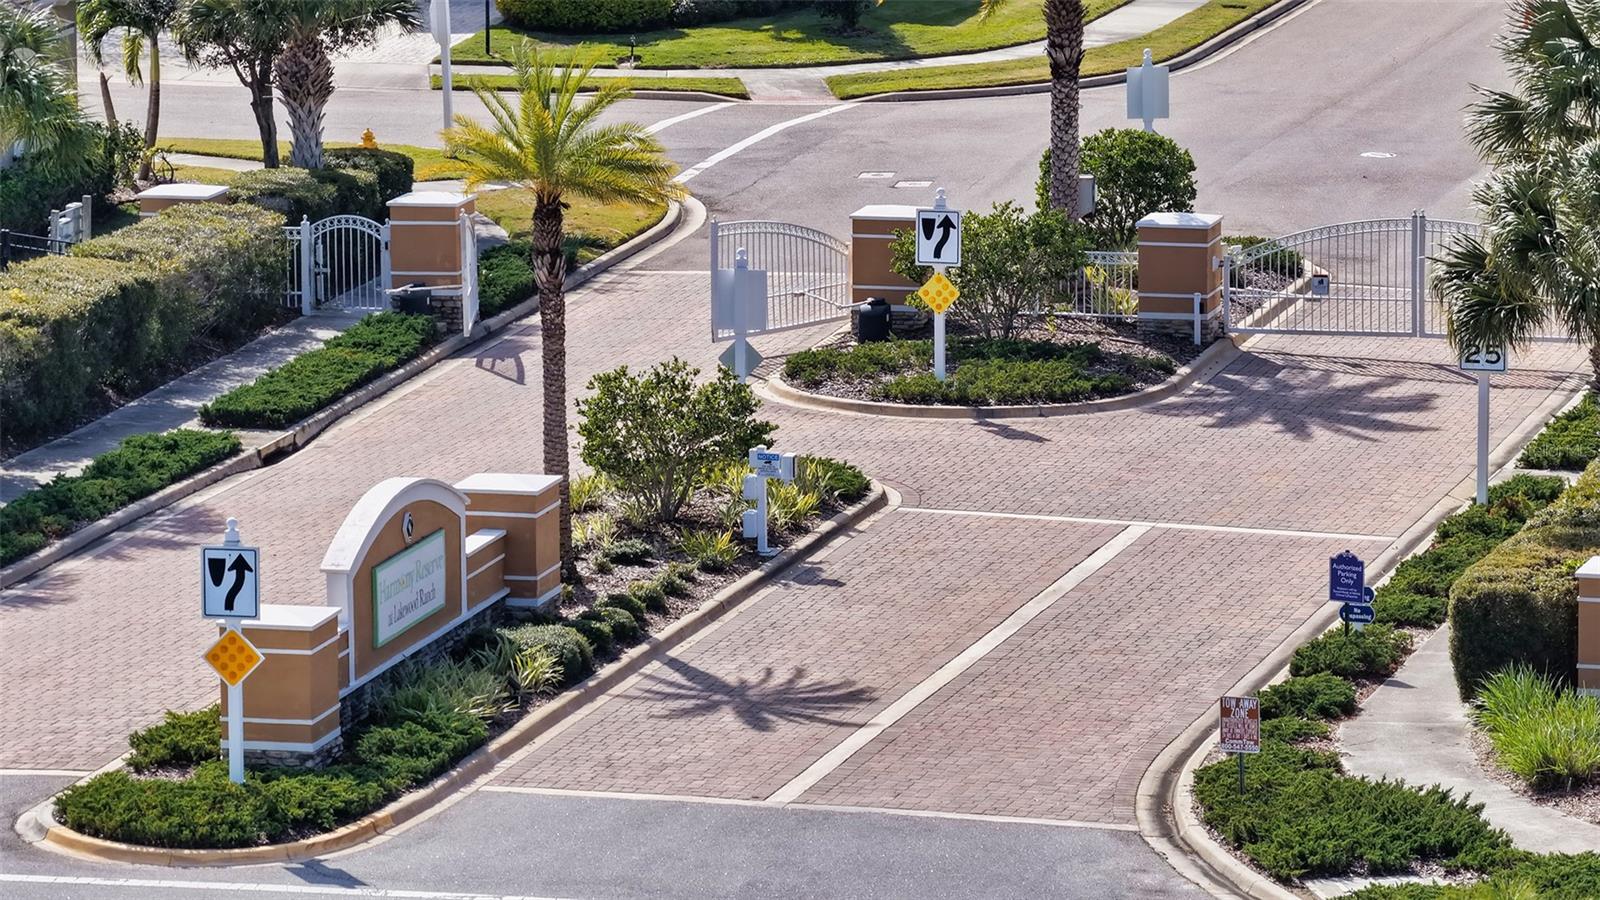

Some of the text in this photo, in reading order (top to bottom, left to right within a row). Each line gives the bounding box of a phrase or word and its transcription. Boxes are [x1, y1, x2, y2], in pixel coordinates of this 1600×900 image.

[1465, 344, 1501, 364] 25
[1332, 563, 1362, 572] Authorized
[1337, 571, 1357, 579] Parking
[379, 569, 415, 604] Harmony
[1340, 577, 1354, 586] Only
[1222, 698, 1258, 710] TOW AWAY
[1231, 708, 1249, 719] ZONE
